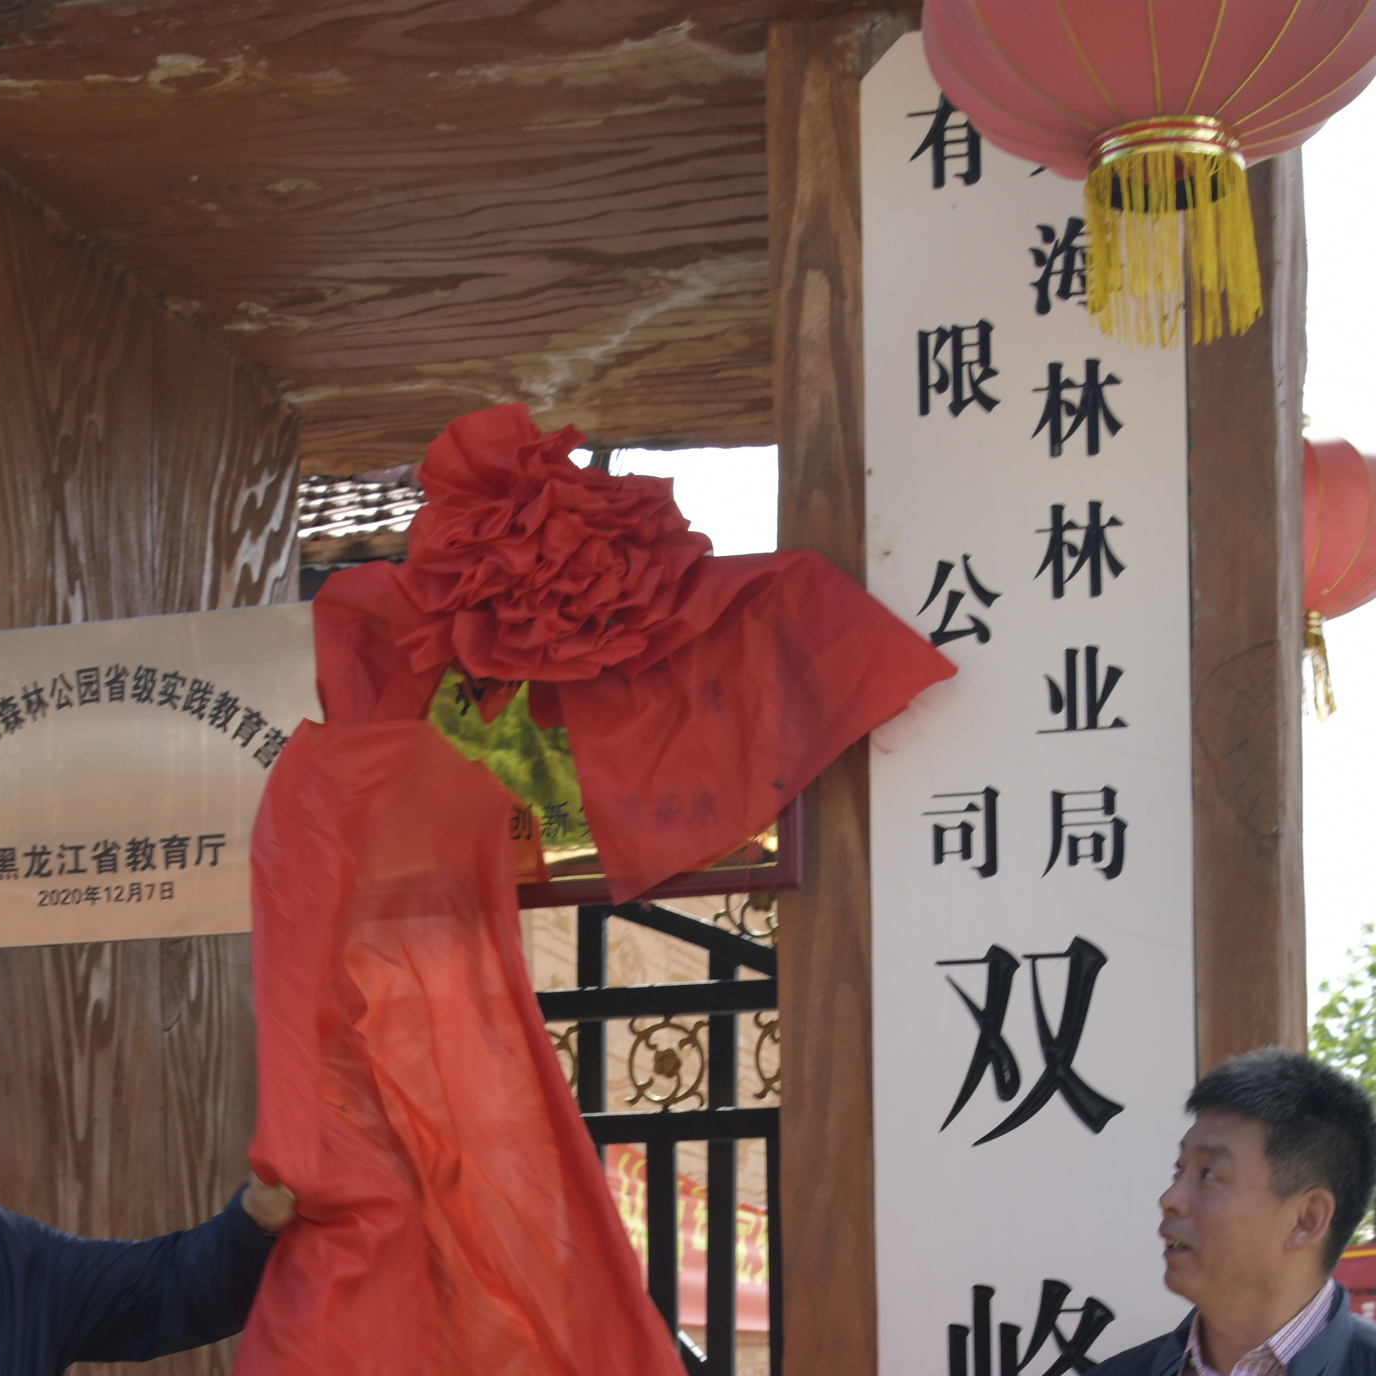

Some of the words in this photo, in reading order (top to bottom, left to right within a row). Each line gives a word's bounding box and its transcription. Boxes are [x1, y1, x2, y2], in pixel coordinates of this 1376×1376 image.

[907, 93, 1001, 880] 有限公司
[1028, 165, 1128, 881] 海林林业局
